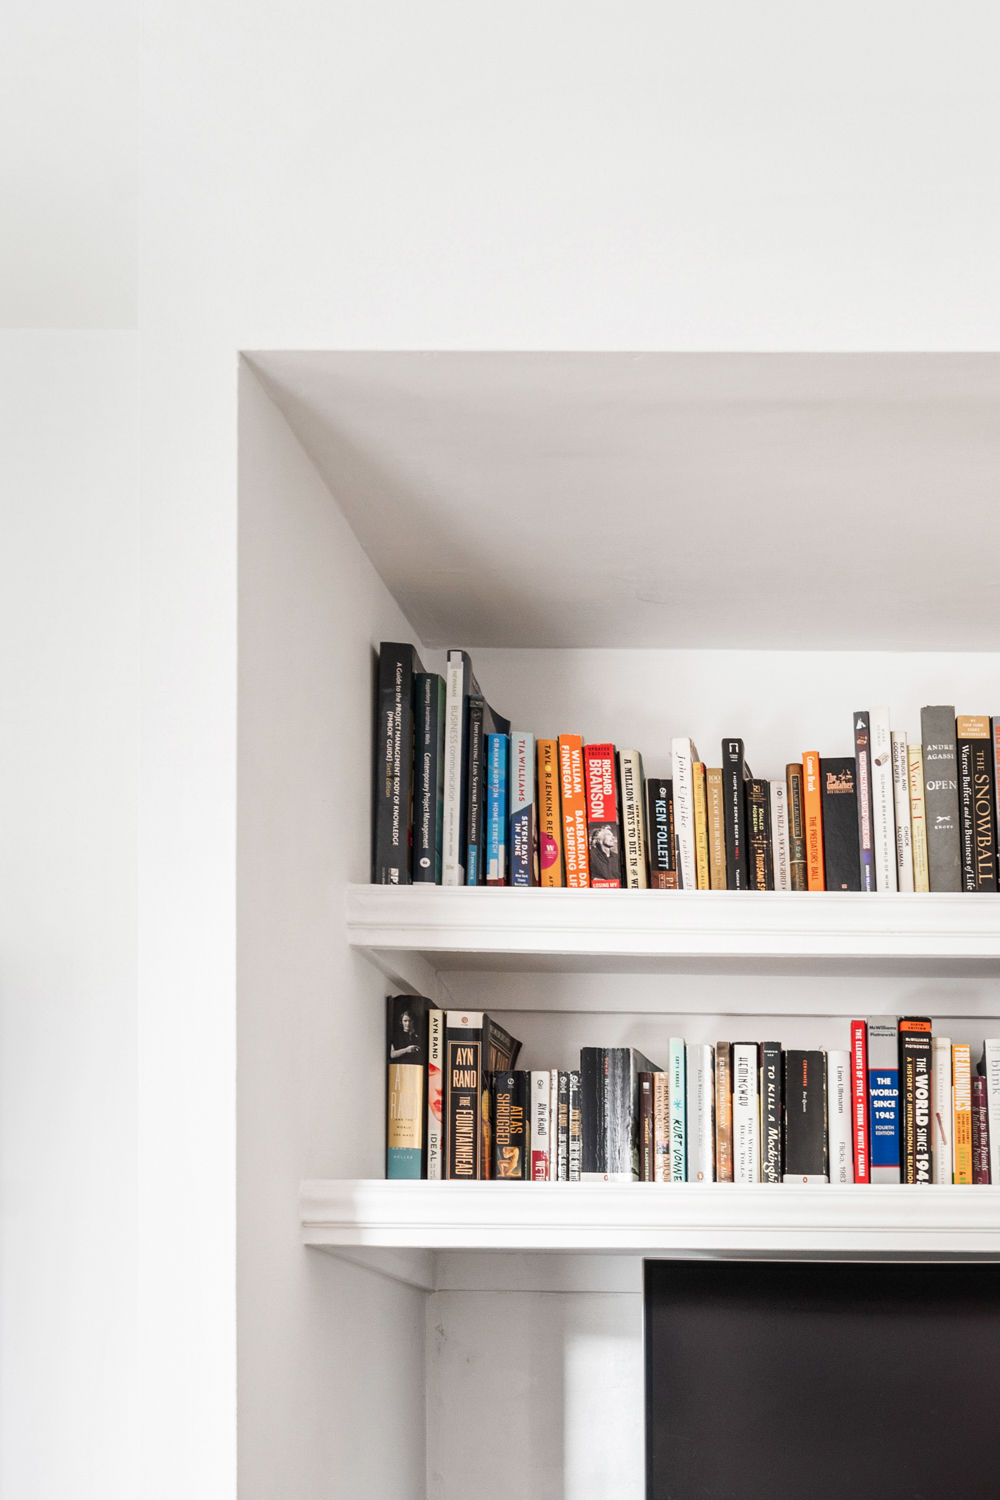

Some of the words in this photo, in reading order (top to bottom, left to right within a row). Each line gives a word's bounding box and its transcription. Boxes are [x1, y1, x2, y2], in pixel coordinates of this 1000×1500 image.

[449, 705, 458, 743] BUSINESS
[422, 752, 431, 792] Contemporary
[561, 745, 572, 798] FINNEGAN
[571, 750, 581, 792] WILLIAM
[976, 750, 984, 770] THE
[590, 759, 604, 817] BRANSON
[602, 759, 612, 794] RICHARD
[624, 767, 633, 801] MILLION
[807, 775, 815, 791] Bruck
[926, 780, 956, 790] OPEN
[962, 776, 971, 804] Buffett
[422, 792, 430, 811] Project
[626, 803, 635, 825] WAYS
[655, 800, 666, 821] KEN
[421, 812, 430, 848] Management
[514, 823, 522, 832] IN
[628, 827, 635, 837] TO
[974, 774, 992, 883] SNOWBALL
[656, 825, 668, 868] FOLLETT
[629, 858, 637, 866] IN
[966, 874, 975, 890] Life
[456, 1047, 473, 1065] AYN
[916, 1057, 926, 1072] THE
[453, 1069, 476, 1087] RAND
[954, 1047, 970, 1110] FREAKONOMICS
[459, 1096, 470, 1106] THE
[915, 1074, 928, 1125] WORLD
[496, 1093, 511, 1144] SHRUGGED
[509, 1105, 522, 1133] ATLAS
[673, 1118, 682, 1145] KURT
[455, 1109, 473, 1174] FOUNTAINHEAD
[916, 1128, 927, 1150] SINCE
